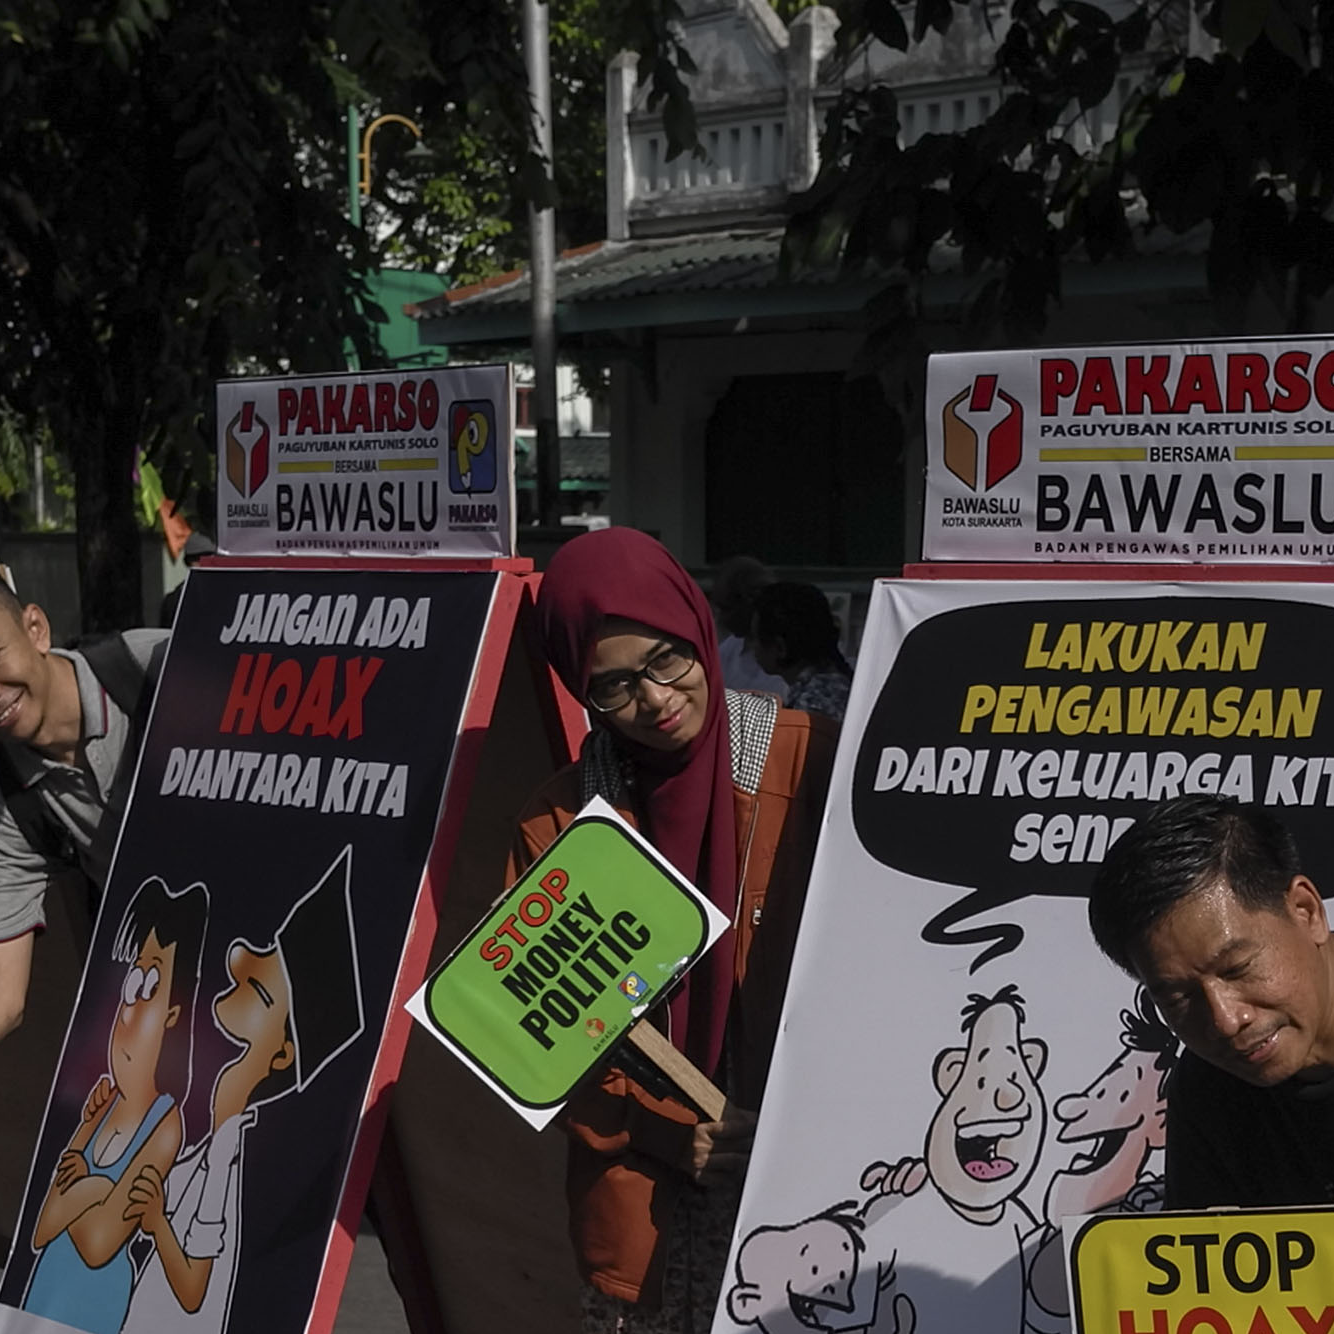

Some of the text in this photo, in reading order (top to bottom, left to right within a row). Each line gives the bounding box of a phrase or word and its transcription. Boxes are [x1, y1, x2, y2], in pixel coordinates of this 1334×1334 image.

[278, 378, 440, 436] PAKARSO
[1040, 423, 1171, 437] PAGUYUBAN
[1177, 421, 1288, 435] KARTUNIS
[278, 437, 439, 454] PAGUYUBAN KARTUNIS SOLO
[334, 459, 377, 473] BERSAMA
[1150, 446, 1232, 462] BERSAMA
[227, 503, 268, 518] BAWASLU
[277, 481, 438, 532] BAWASLU
[448, 504, 498, 524] PAKARSO
[942, 517, 1023, 528] KOTA SURAKARTA
[943, 498, 1020, 514] BAWASLU
[276, 539, 440, 550] BADAN PENGAWAS PEMILIHAN UMUM
[1034, 542, 1090, 553] BADAN
[1096, 543, 1190, 554] PENGAWAS
[1197, 543, 1293, 555] PEMILIHAN
[353, 596, 432, 649] ADA
[1023, 620, 1268, 673] LAKUKAN
[219, 652, 386, 741] HOAX
[958, 684, 1323, 739] PENGAWASAN
[159, 747, 409, 819] DIANTARA KITA
[873, 746, 991, 796] DARI
[479, 868, 570, 972] STOP
[500, 891, 606, 1007] MONEY
[519, 910, 651, 1051] POLITIC
[1144, 1231, 1316, 1296] STOP
